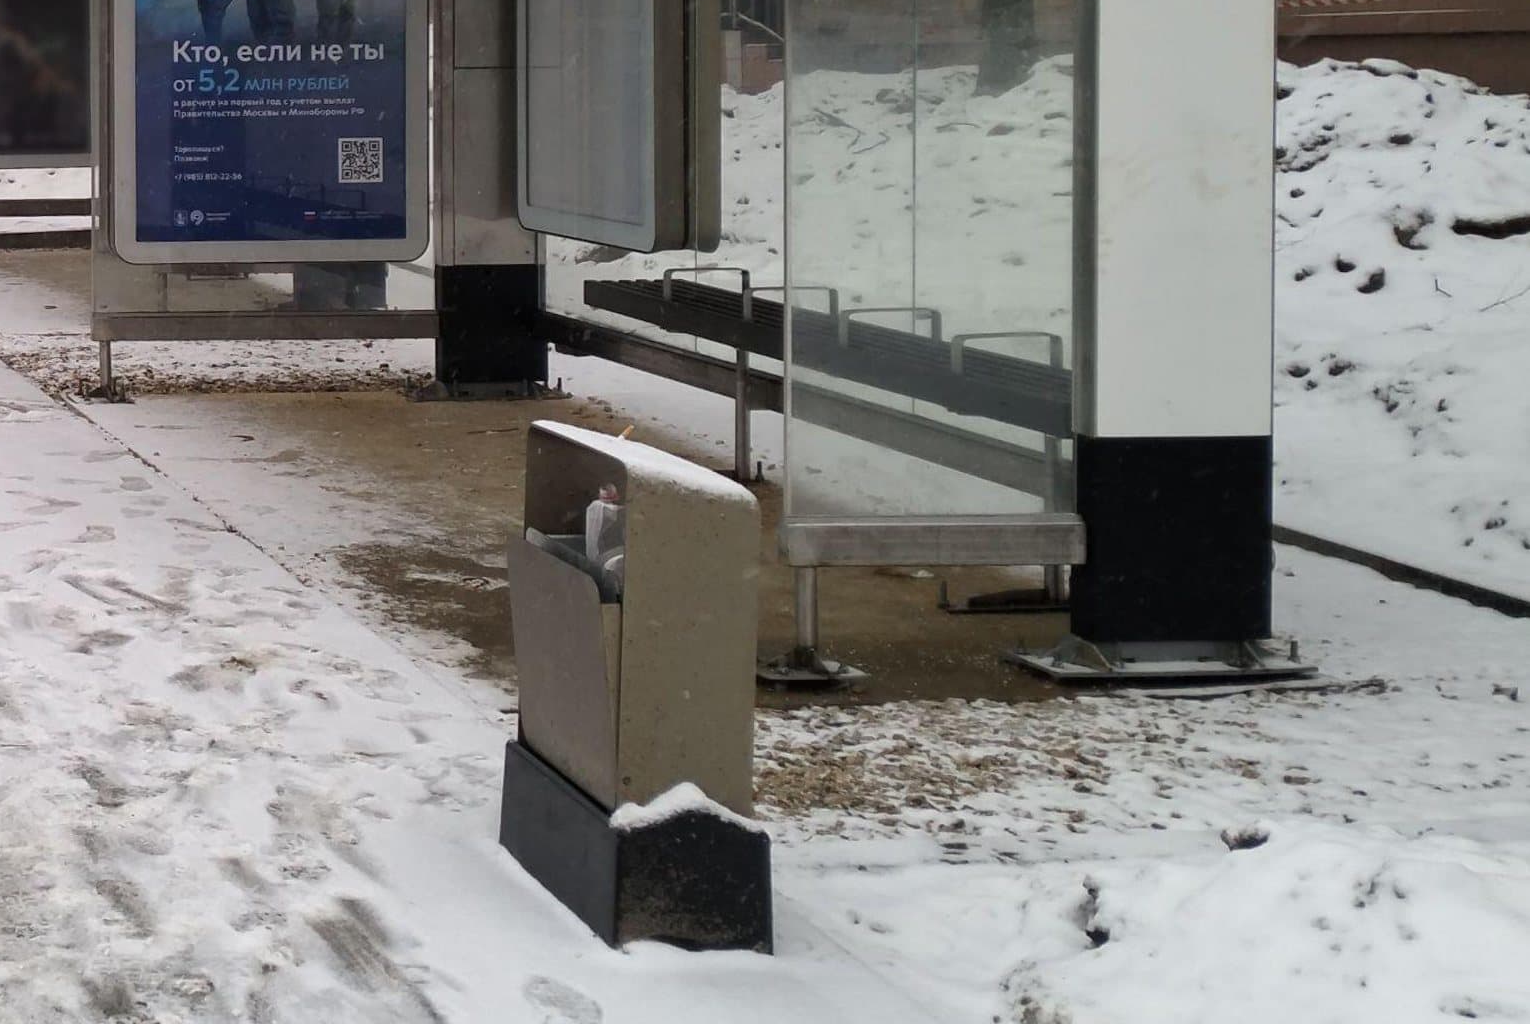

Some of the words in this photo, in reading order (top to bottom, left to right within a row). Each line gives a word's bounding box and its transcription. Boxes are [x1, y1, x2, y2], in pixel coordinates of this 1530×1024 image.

[173, 40, 229, 66] Кто,
[236, 45, 302, 62] если
[311, 44, 343, 62] не
[350, 43, 385, 61] ты
[198, 68, 240, 95] 5,2
[244, 78, 283, 91] МЛН
[288, 74, 350, 90] РУБЛЕЙ
[218, 99, 229, 107] на
[230, 98, 264, 107] первый
[266, 98, 281, 106] год
[173, 109, 241, 118] Правительства
[243, 109, 279, 117] Москвы
[289, 107, 349, 116] Минобороны
[351, 107, 365, 115] РФ
